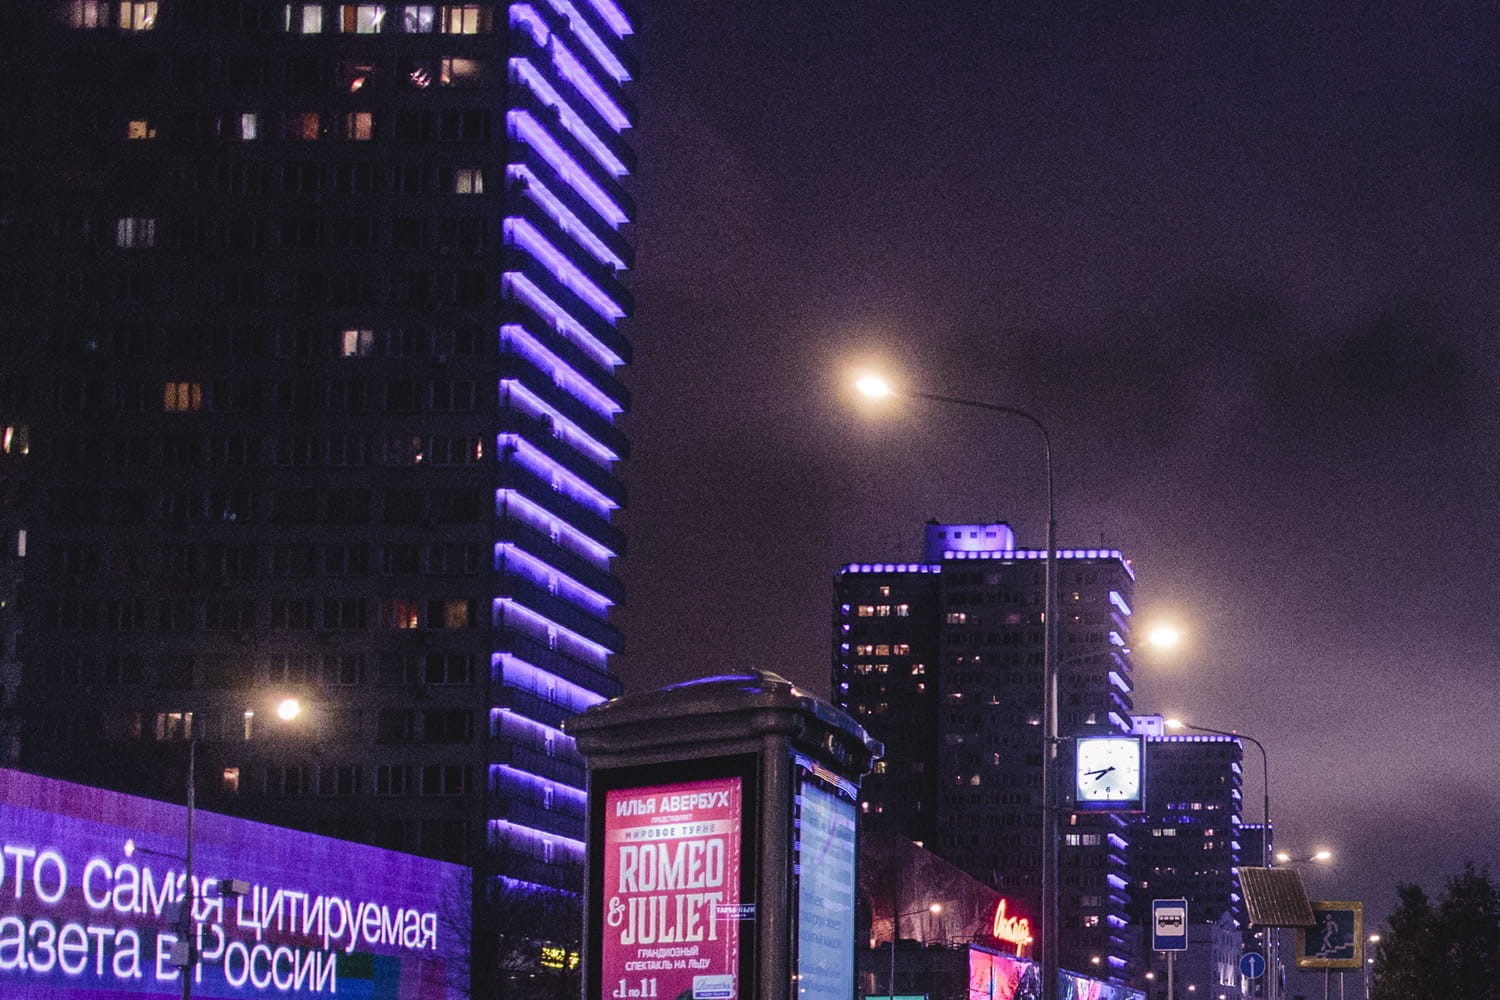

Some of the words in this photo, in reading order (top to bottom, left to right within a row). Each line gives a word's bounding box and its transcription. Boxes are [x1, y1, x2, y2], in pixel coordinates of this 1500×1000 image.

[616, 797, 656, 816] ИЛЬЯ
[660, 790, 730, 813] АВЕРБУХ
[625, 827, 675, 839] МИРОВОЕ
[682, 823, 715, 835] ТУРНЕ
[618, 838, 724, 894] ROMEO
[0, 845, 68, 903] то
[82, 858, 224, 924] самая
[236, 884, 438, 953] цитируемая
[607, 896, 626, 928] &
[620, 892, 723, 945] JULIET
[195, 921, 338, 994] России
[625, 960, 673, 971] СПЕКТАКЛЬ
[674, 960, 686, 969] НА
[688, 958, 711, 969] ЛЬДУ
[637, 945, 699, 958] ГРАНДИОЗНЫЙ
